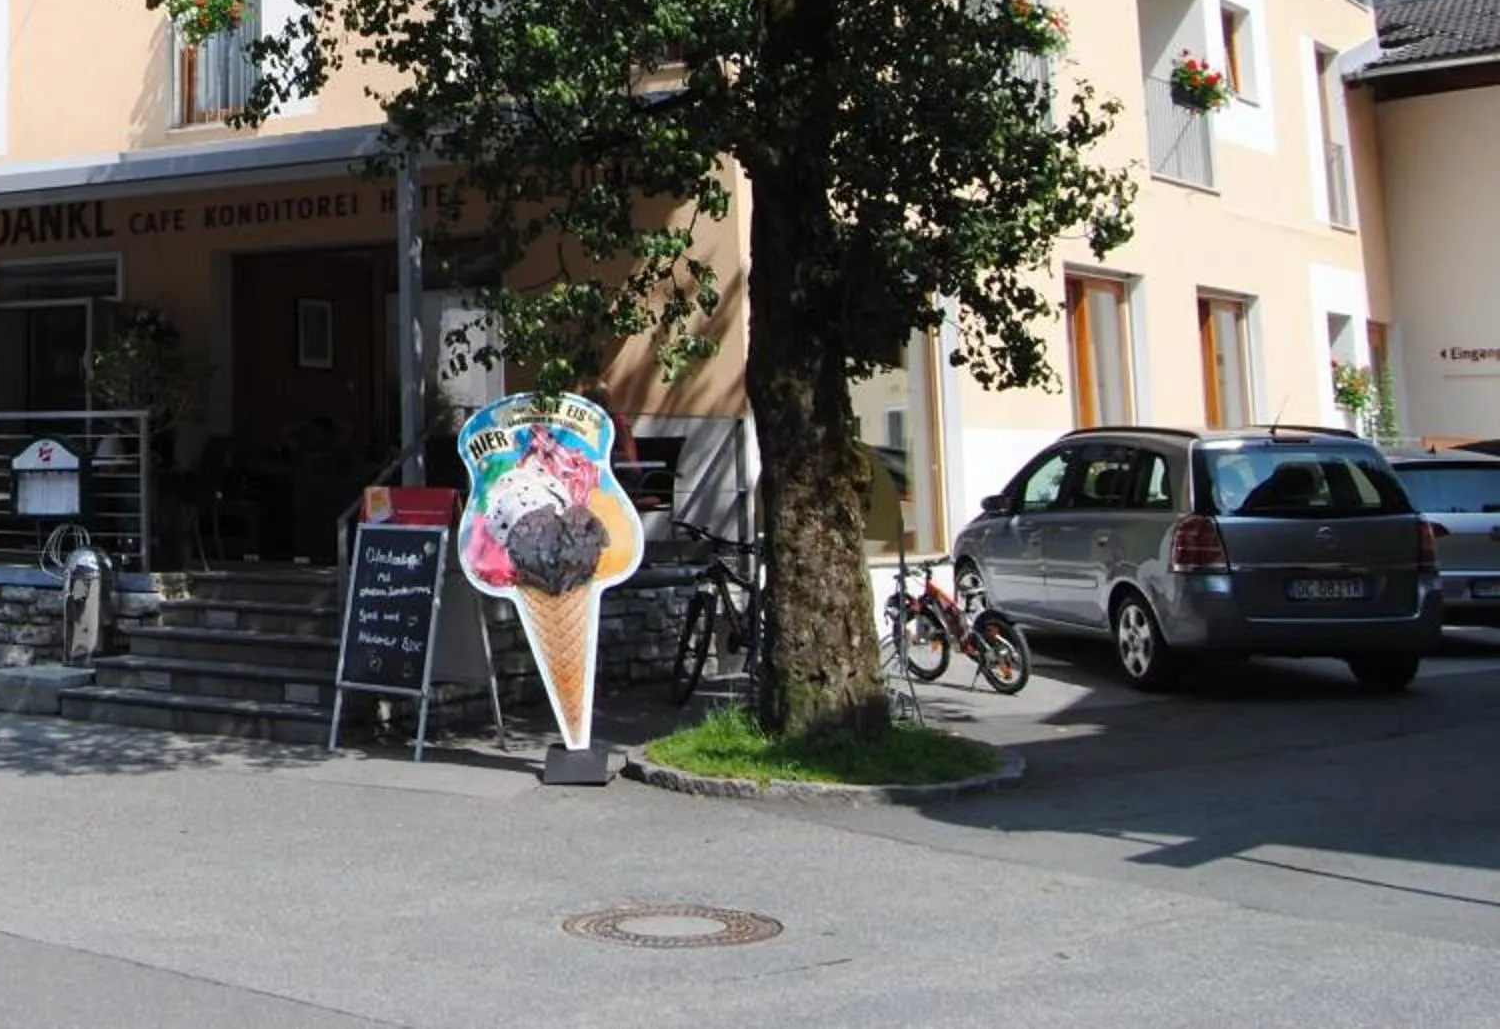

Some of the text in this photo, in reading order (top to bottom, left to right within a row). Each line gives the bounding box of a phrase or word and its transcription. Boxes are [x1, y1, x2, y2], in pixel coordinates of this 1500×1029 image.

[129, 209, 186, 236] CAFE
[203, 192, 358, 230] KONDITOREI
[468, 430, 509, 460] HIER
